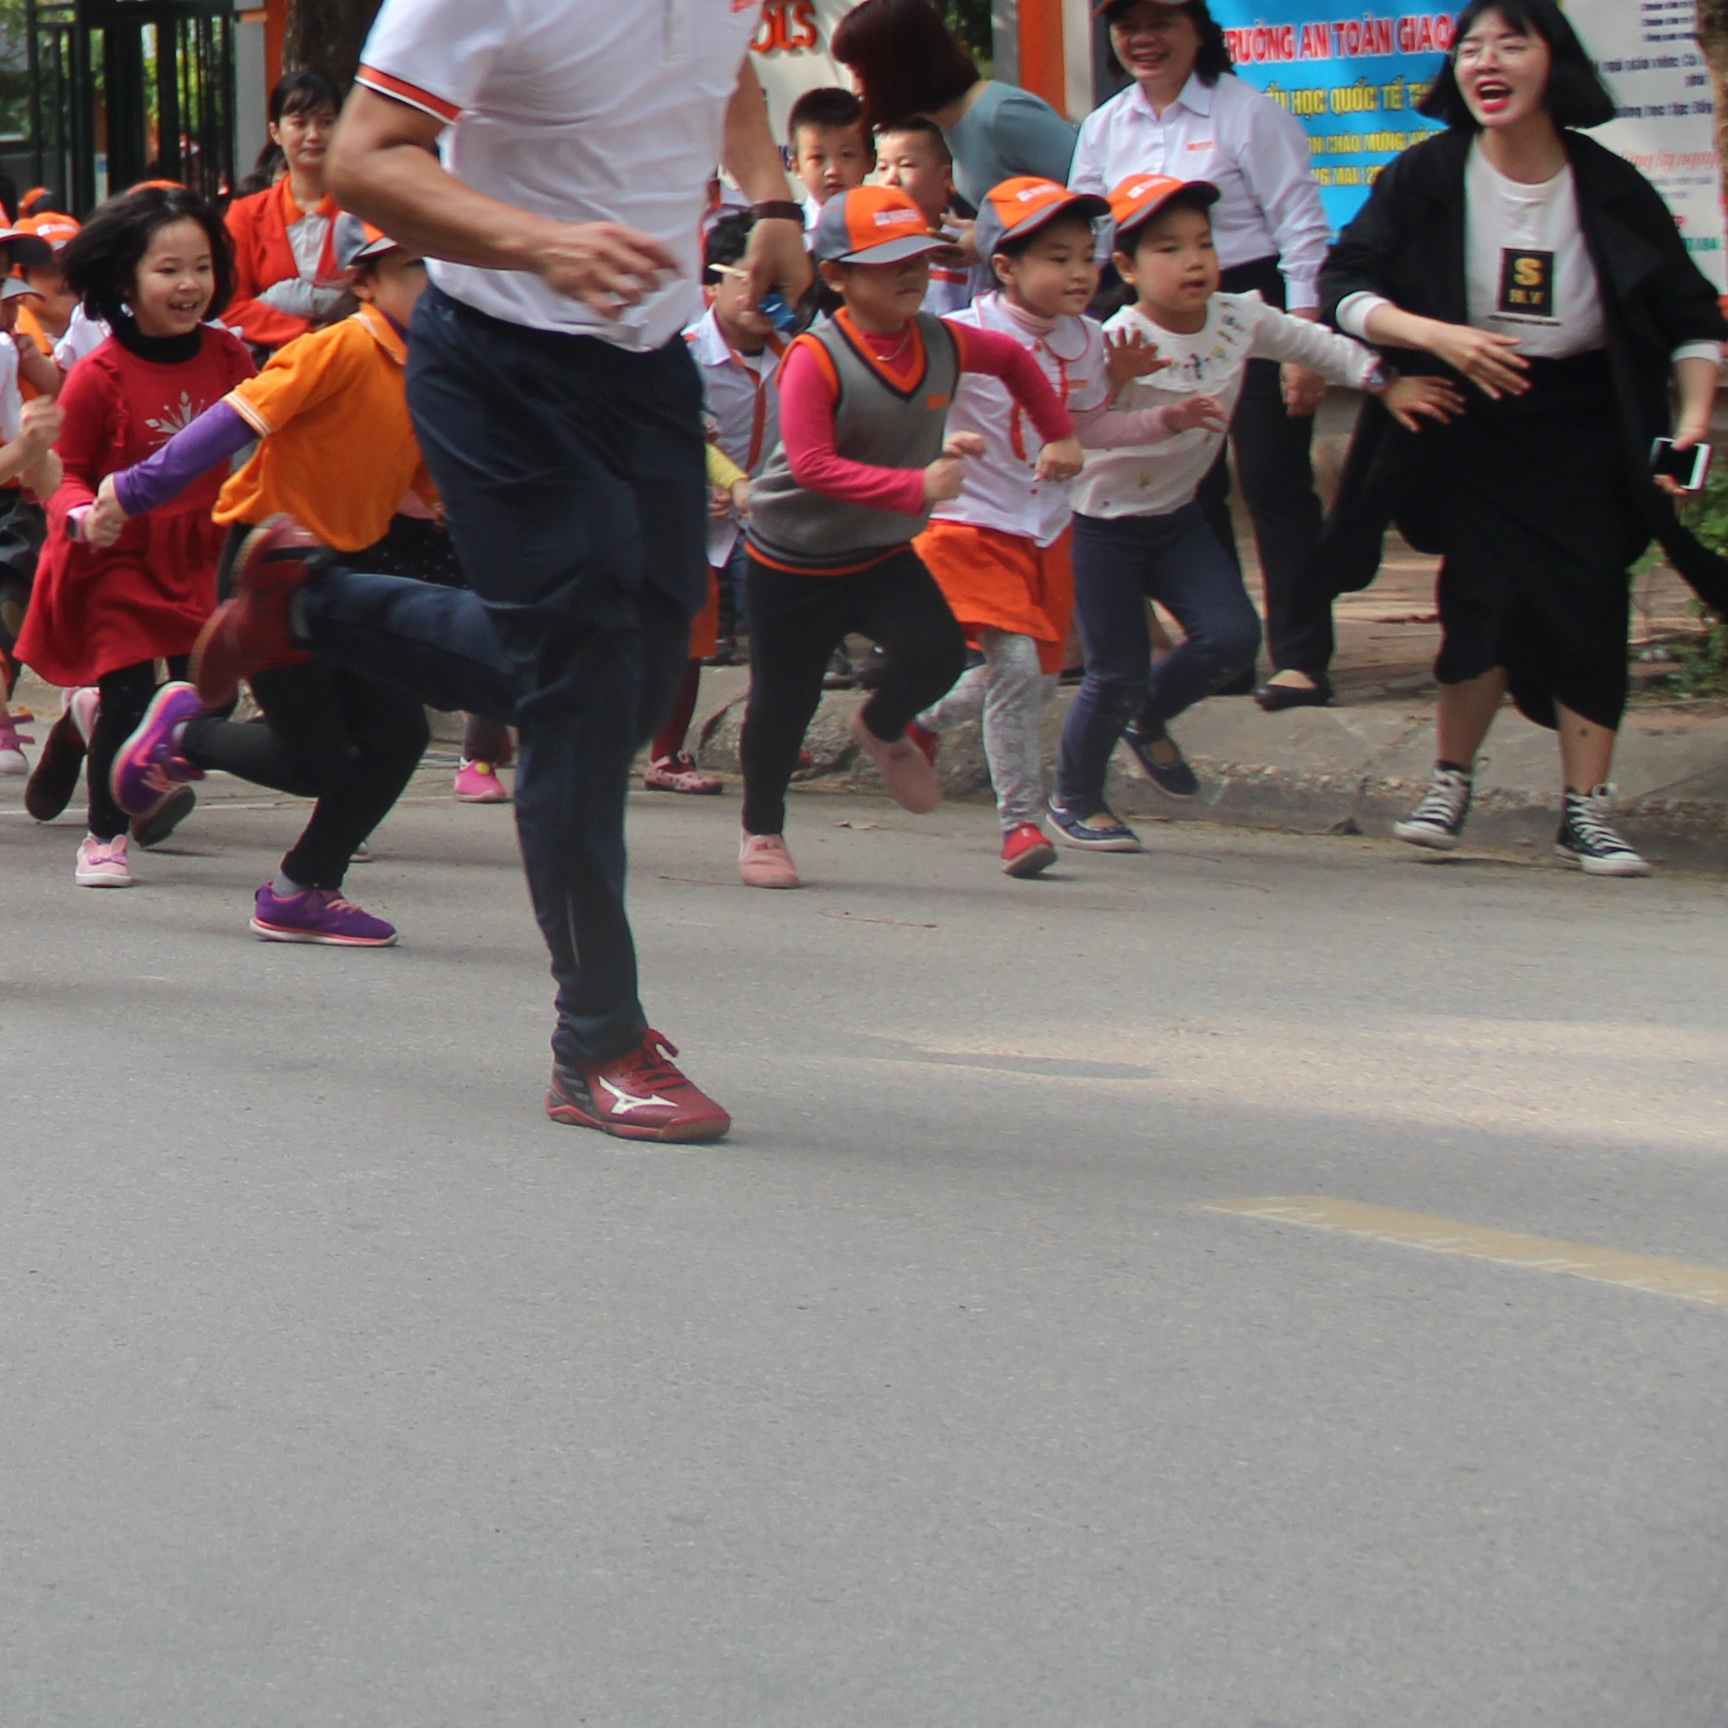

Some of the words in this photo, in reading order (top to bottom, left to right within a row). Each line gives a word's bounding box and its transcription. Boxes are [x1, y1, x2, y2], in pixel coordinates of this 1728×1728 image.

[748, 4, 818, 52] OLS
[1222, 19, 1294, 64] RƯỜNG
[1299, 22, 1332, 61] AN
[1333, 13, 1394, 57] TOÀN
[1397, 14, 1456, 55] GIAO
[1513, 257, 1544, 286] S
